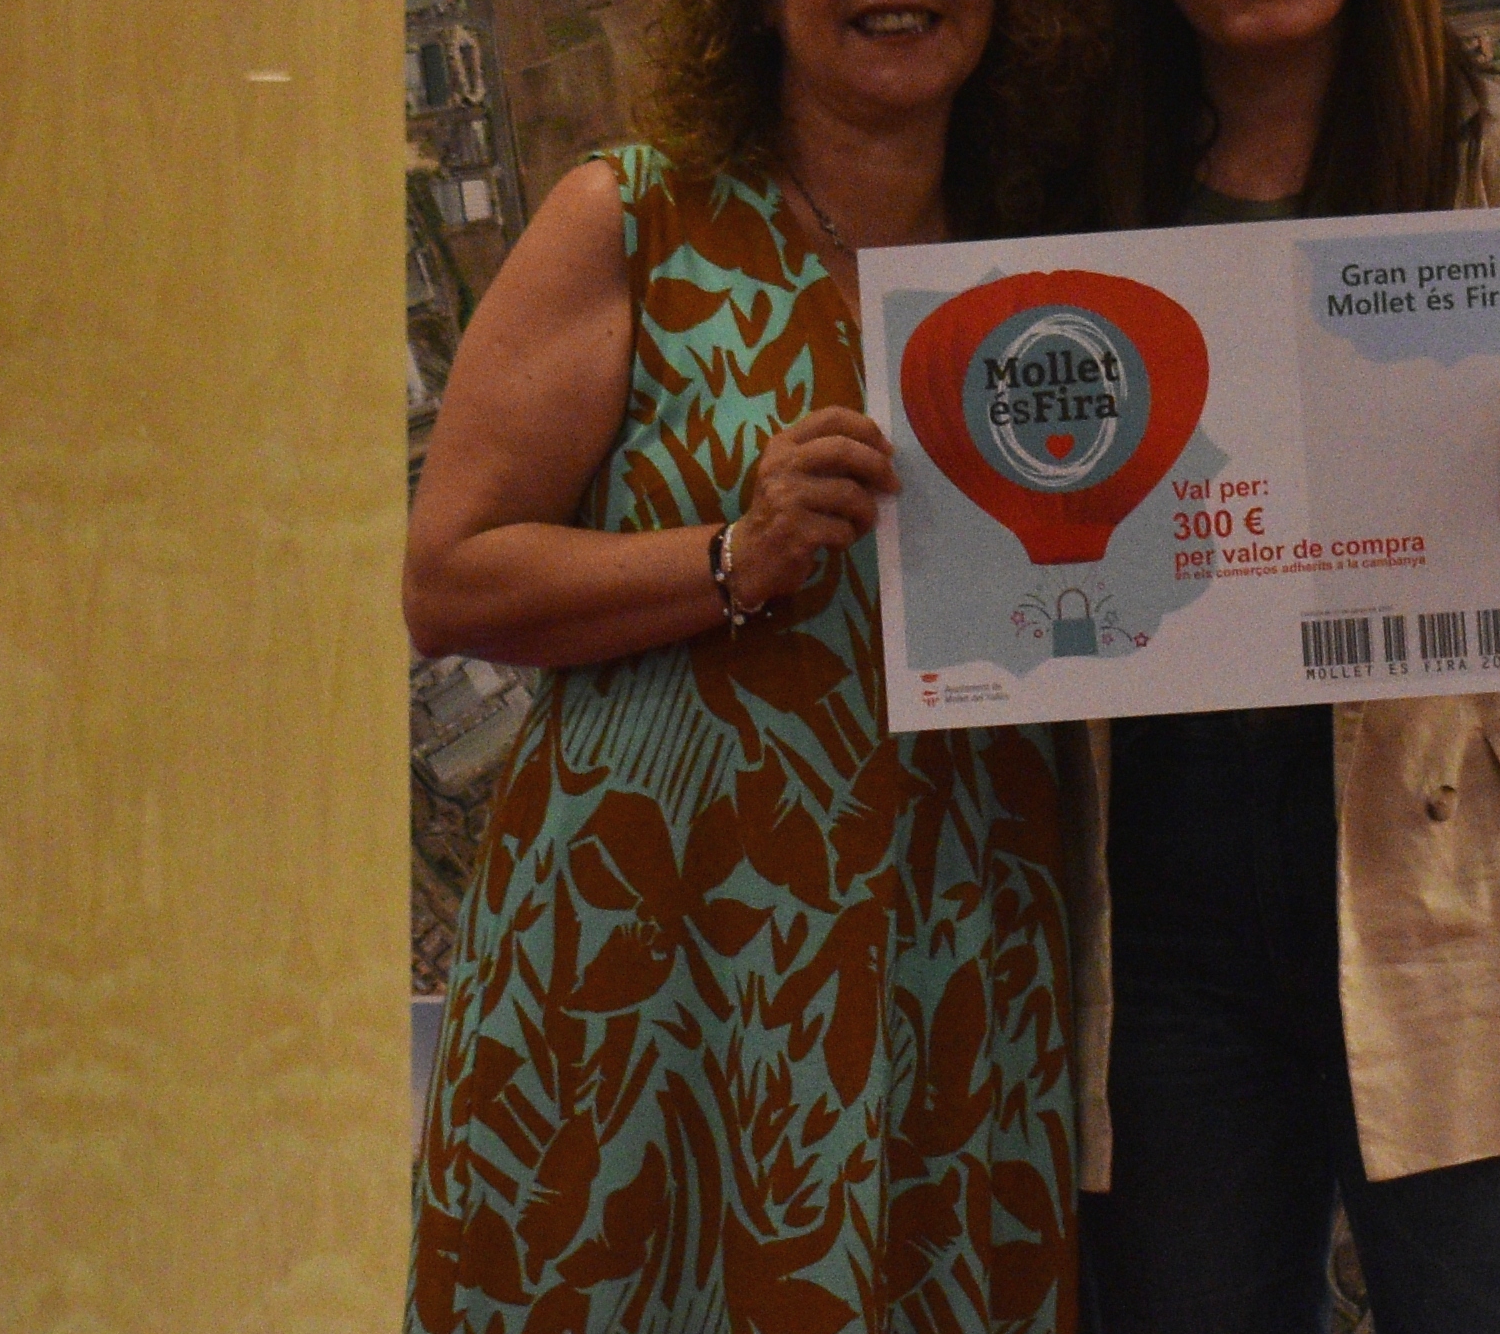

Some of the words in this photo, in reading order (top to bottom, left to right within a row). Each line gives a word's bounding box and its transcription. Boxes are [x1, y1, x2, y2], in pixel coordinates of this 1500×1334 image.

[1341, 264, 1406, 287] Gran
[1418, 255, 1497, 288] premi
[1328, 290, 1415, 316] Mollet
[1427, 286, 1455, 310] és
[983, 350, 1120, 389] Mollet
[989, 386, 1119, 426] ésFira
[1171, 478, 1210, 500] Val
[1220, 480, 1269, 503] per:
[1173, 509, 1233, 541] 300
[1244, 507, 1265, 535] €
[1175, 549, 1215, 572] per
[1222, 542, 1285, 564] valor
[1293, 538, 1323, 559] de
[1331, 536, 1425, 558] compra
[1306, 665, 1372, 680] MOLLET
[1388, 662, 1409, 675] ES
[1423, 658, 1467, 673] FIRA
